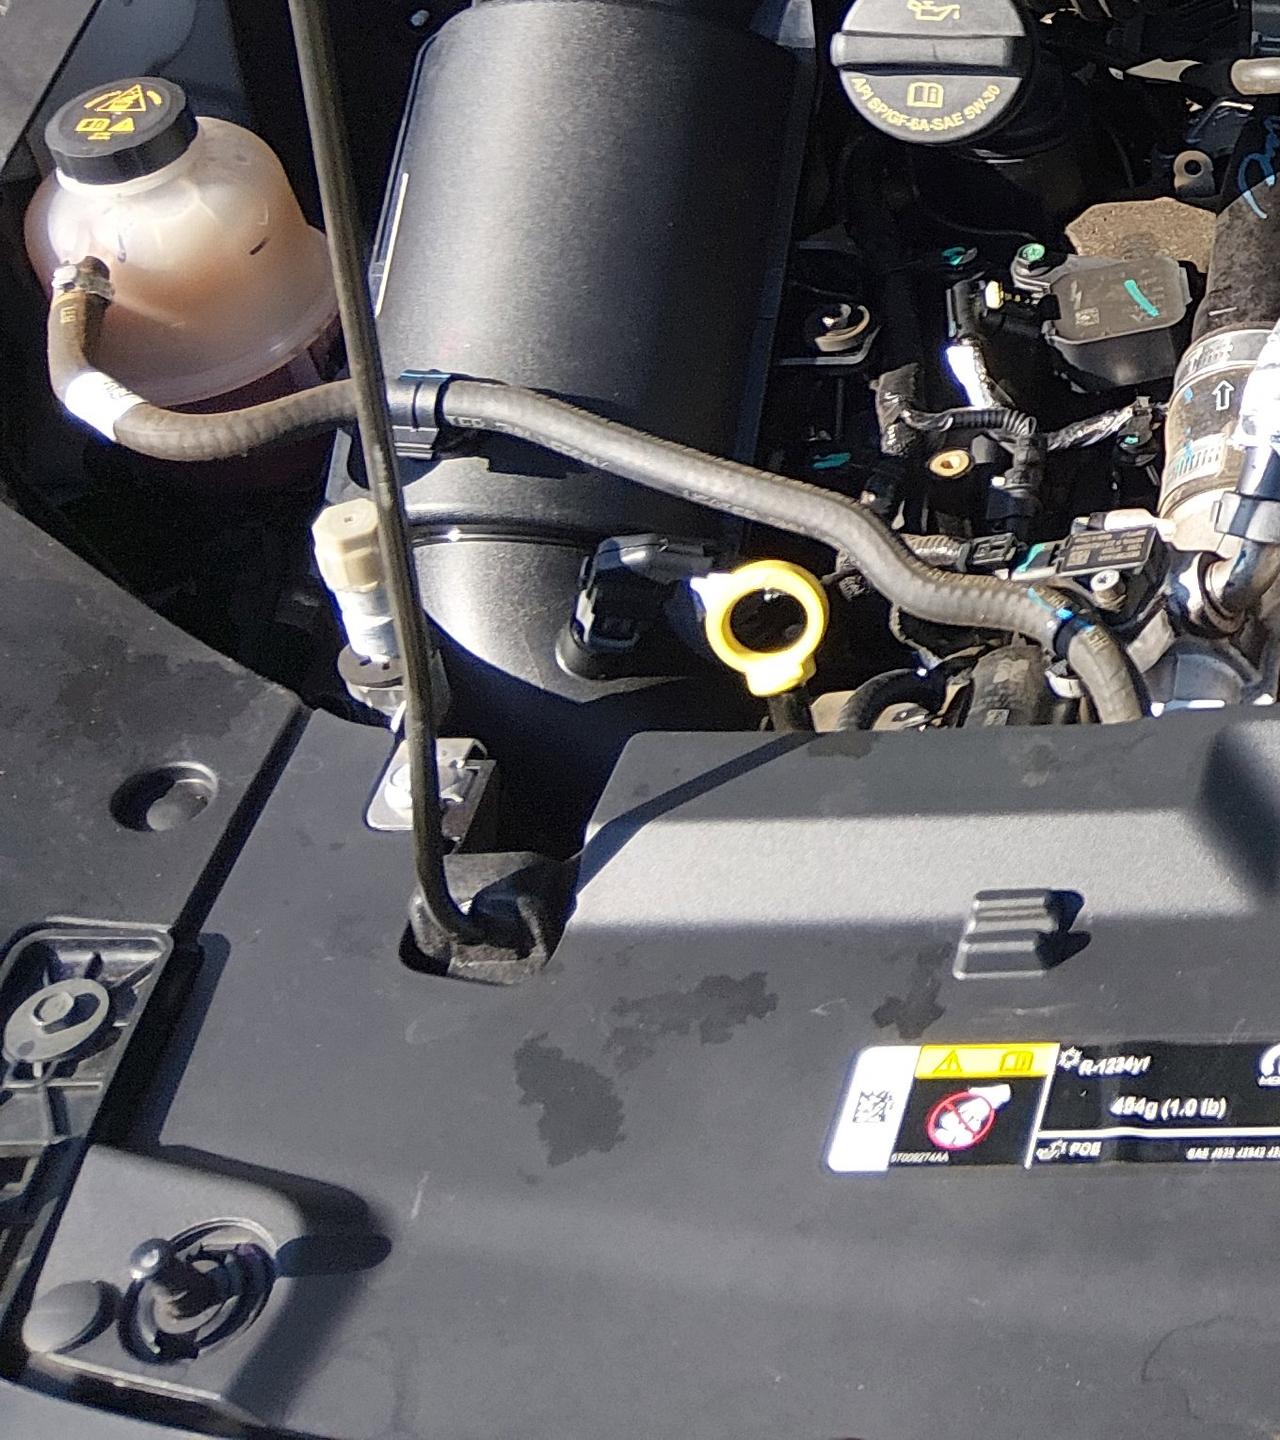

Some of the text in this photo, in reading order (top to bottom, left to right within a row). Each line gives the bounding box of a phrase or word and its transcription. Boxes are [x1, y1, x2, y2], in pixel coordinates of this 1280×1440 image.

[852, 78, 873, 101] API
[1111, 1097, 1227, 1120] 454g (1.0 lb)
